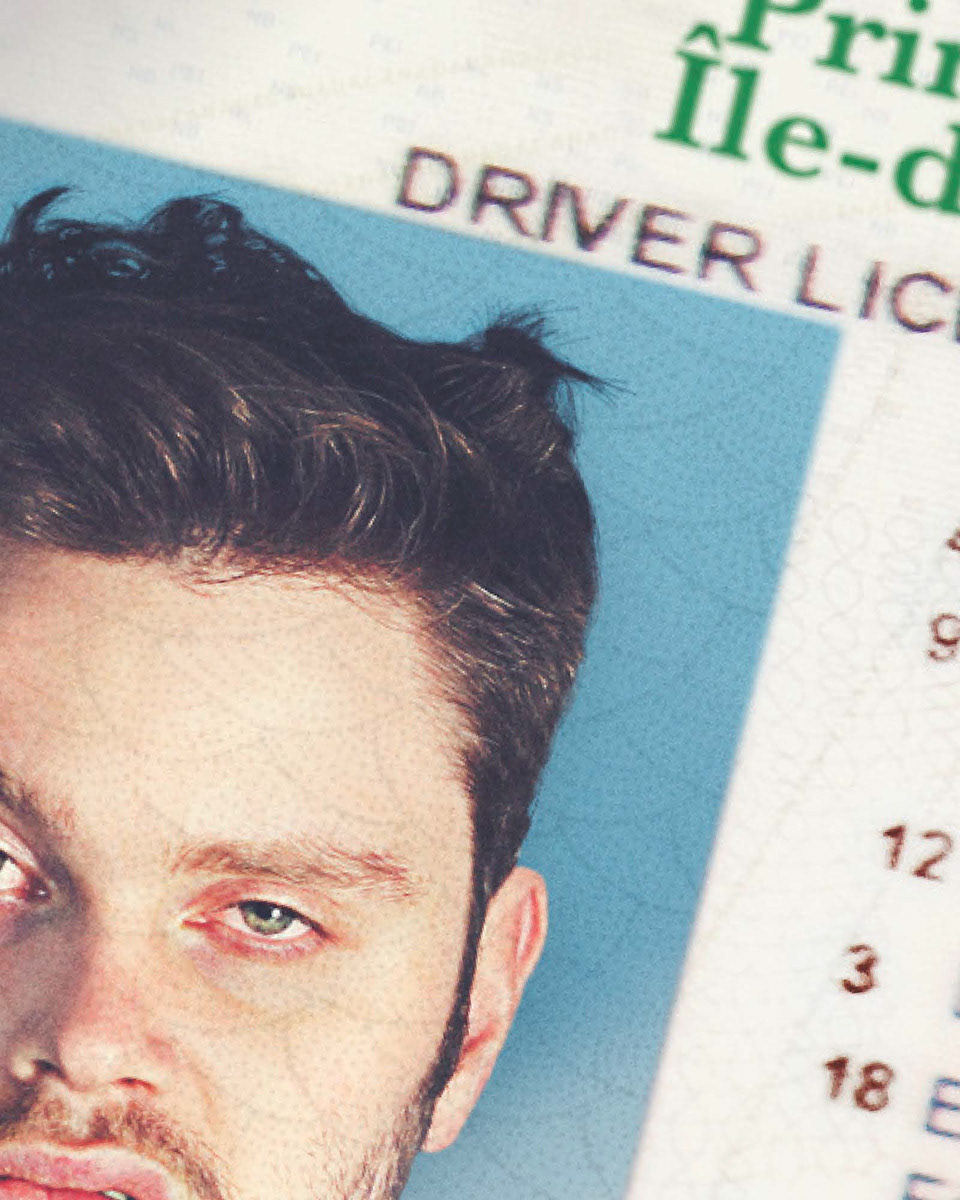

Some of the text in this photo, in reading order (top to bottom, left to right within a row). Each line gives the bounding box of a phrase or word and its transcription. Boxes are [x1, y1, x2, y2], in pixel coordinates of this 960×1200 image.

[395, 145, 960, 343] DRIVER LIC
[882, 823, 954, 881] 12
[841, 943, 880, 995] 3
[825, 1055, 895, 1112] 18
